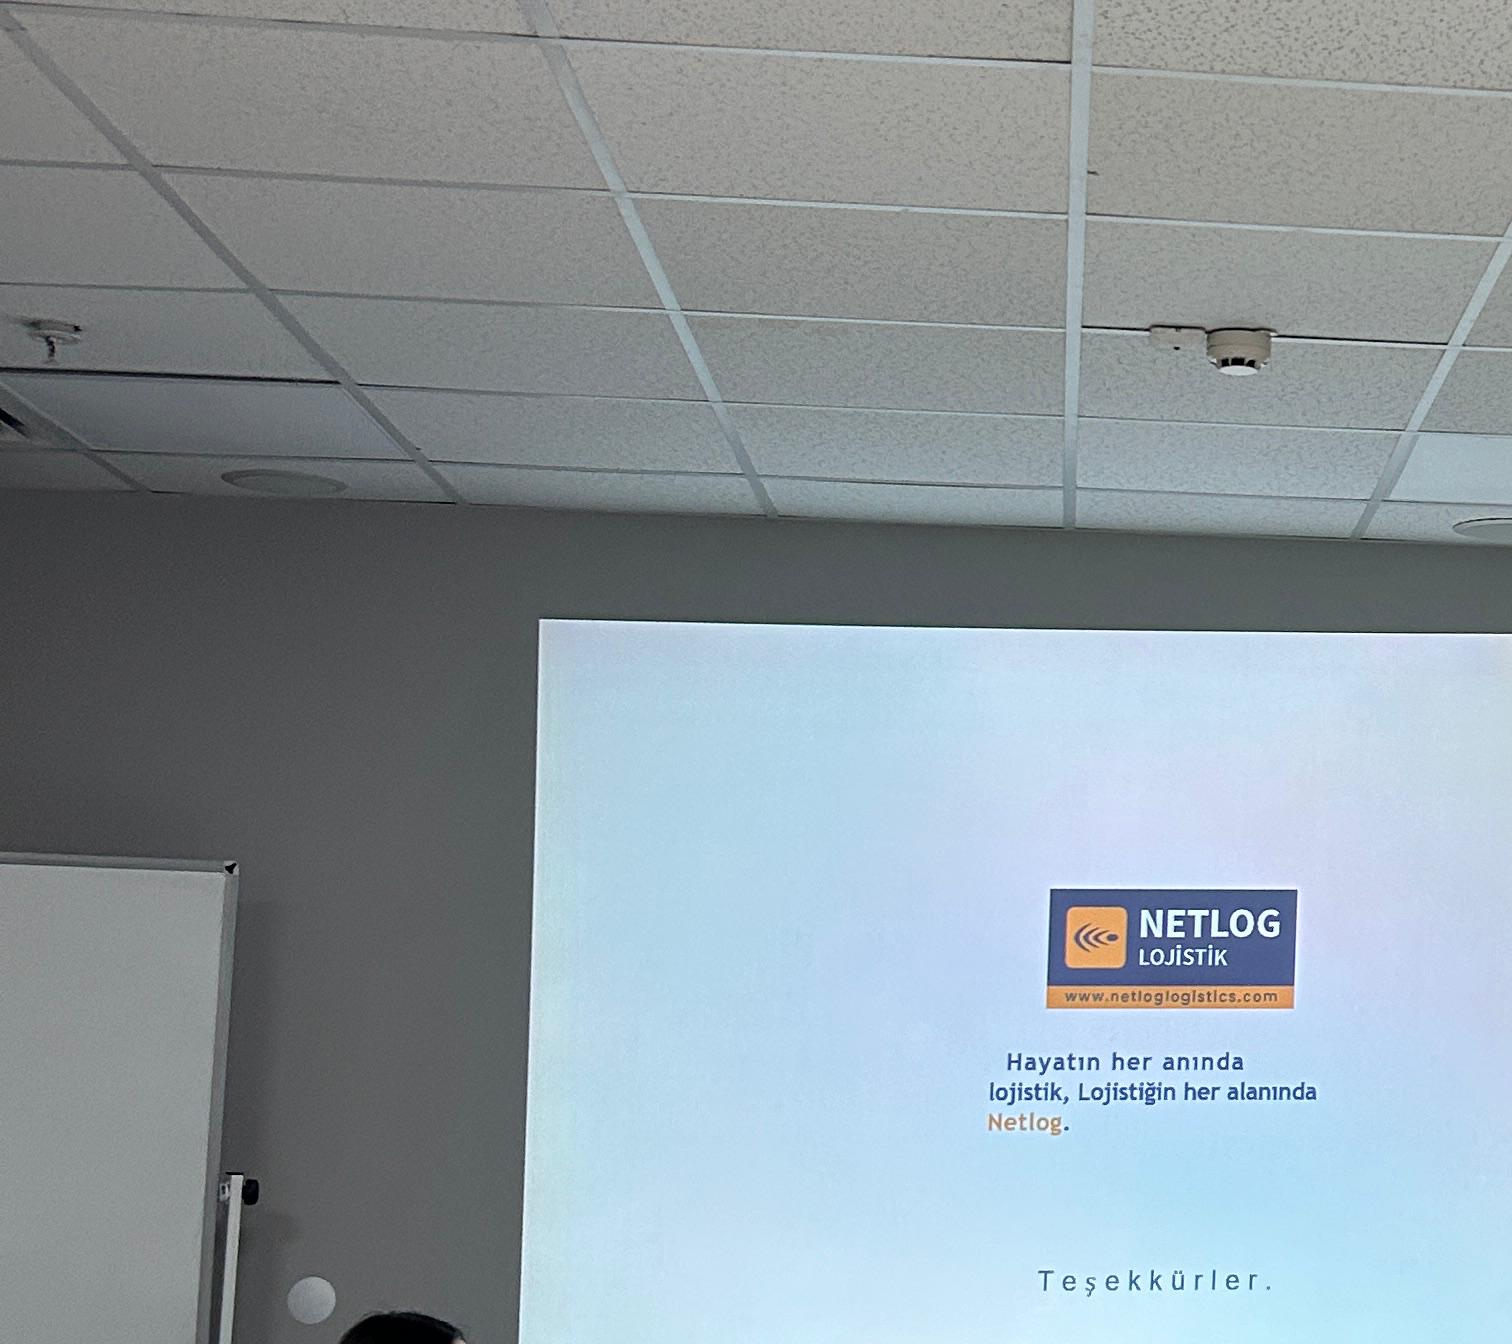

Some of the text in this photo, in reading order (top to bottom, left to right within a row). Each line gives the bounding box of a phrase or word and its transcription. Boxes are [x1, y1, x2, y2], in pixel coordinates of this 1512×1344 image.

[1138, 908, 1282, 939] NETLOG
[1138, 944, 1229, 967] LOJİSTİK
[1064, 989, 1279, 1006] www.netloglogistics.com
[1006, 1052, 1245, 1075] Hayatın her anında
[989, 1082, 1318, 1105] lojistik, Lojistiğin her alanında
[987, 1112, 1070, 1136] Netlog.
[1037, 1269, 1272, 1297] Teşekkürler.
